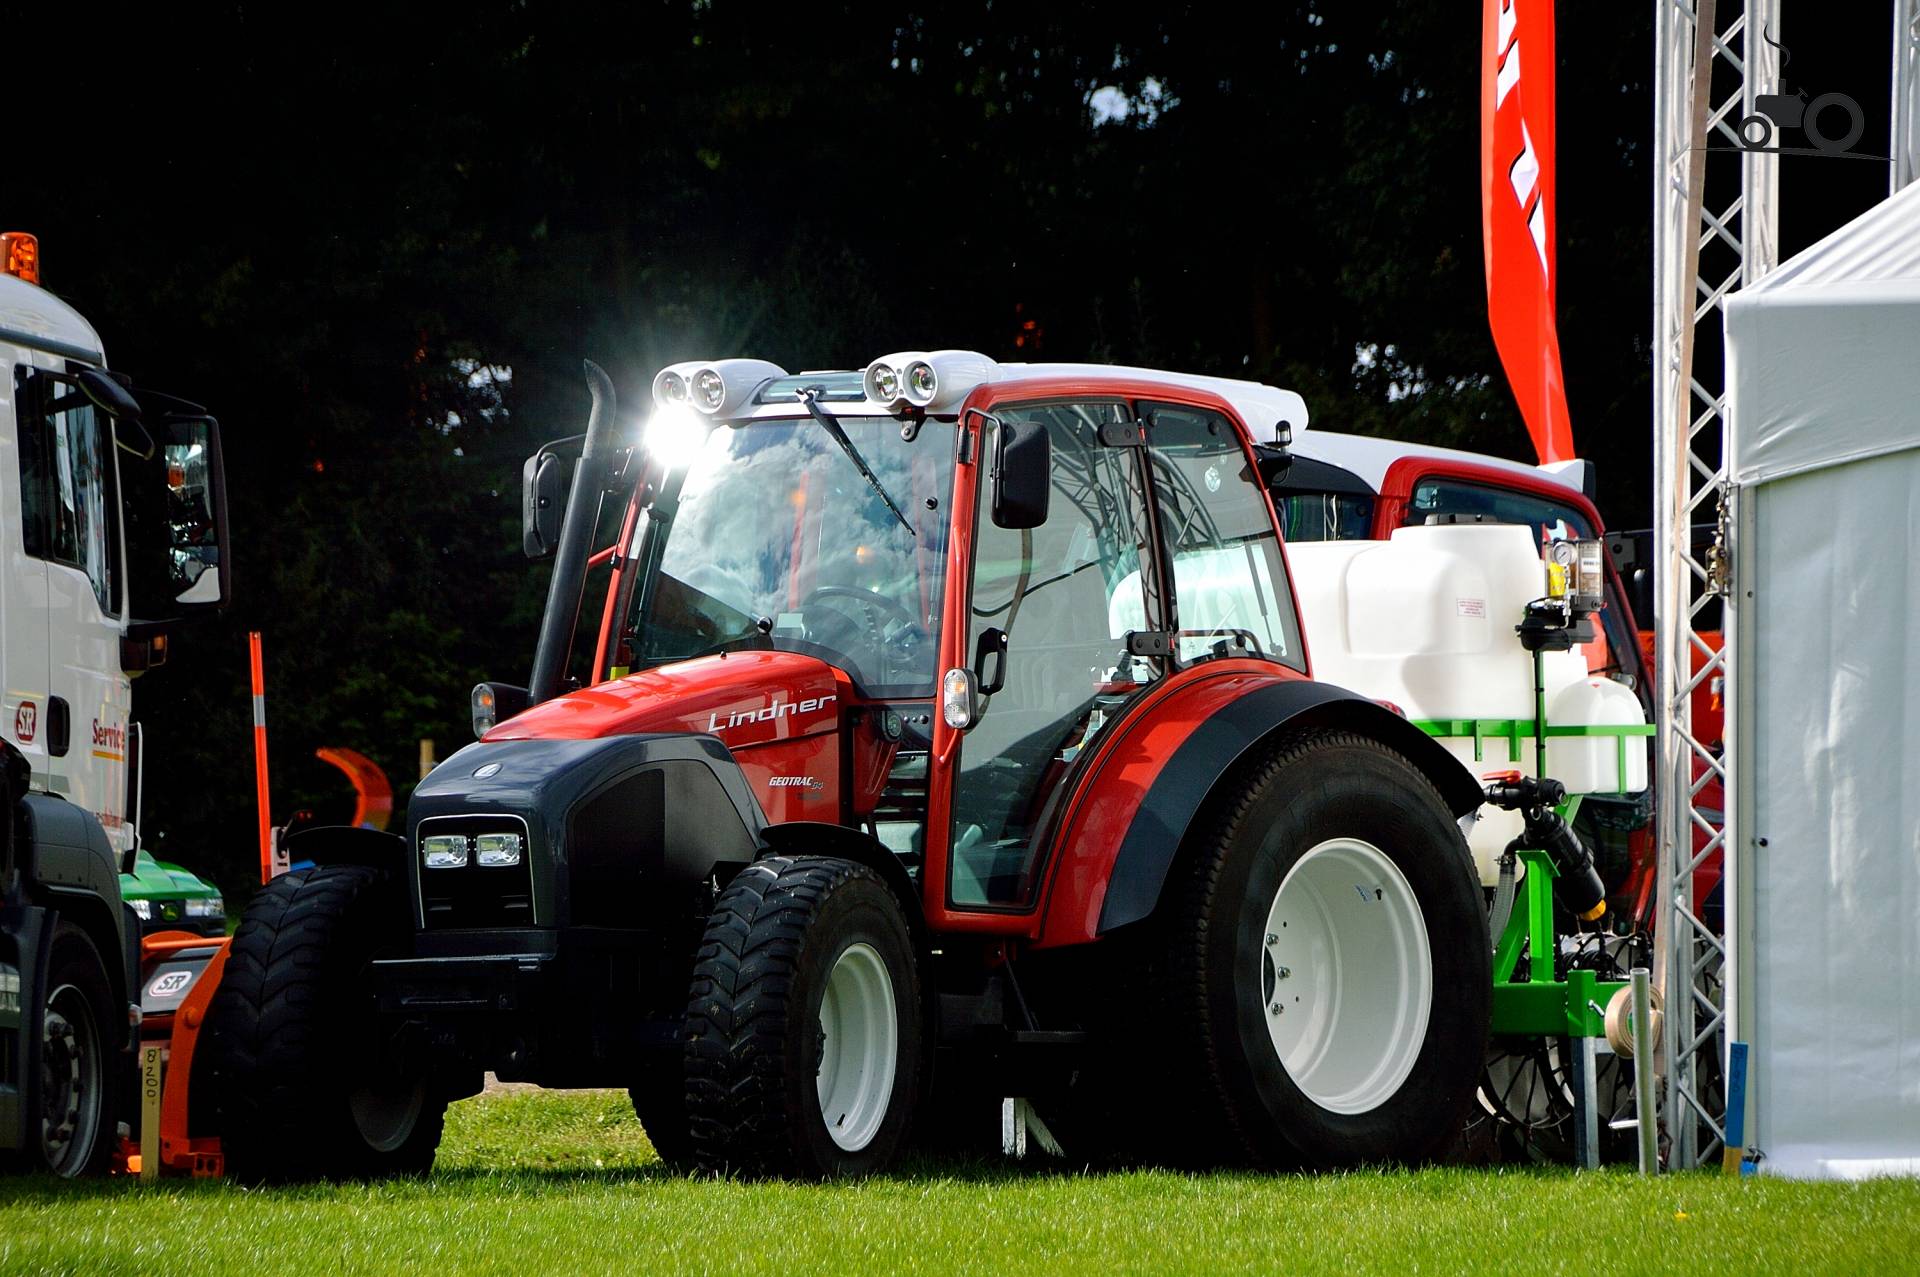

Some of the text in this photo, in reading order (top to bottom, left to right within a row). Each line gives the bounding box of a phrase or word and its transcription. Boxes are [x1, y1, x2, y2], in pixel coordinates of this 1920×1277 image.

[18, 706, 35, 736] SR
[707, 695, 837, 732] Lindner
[92, 718, 126, 751] Service
[768, 776, 814, 786] GEOTRAC
[157, 975, 186, 991] SR
